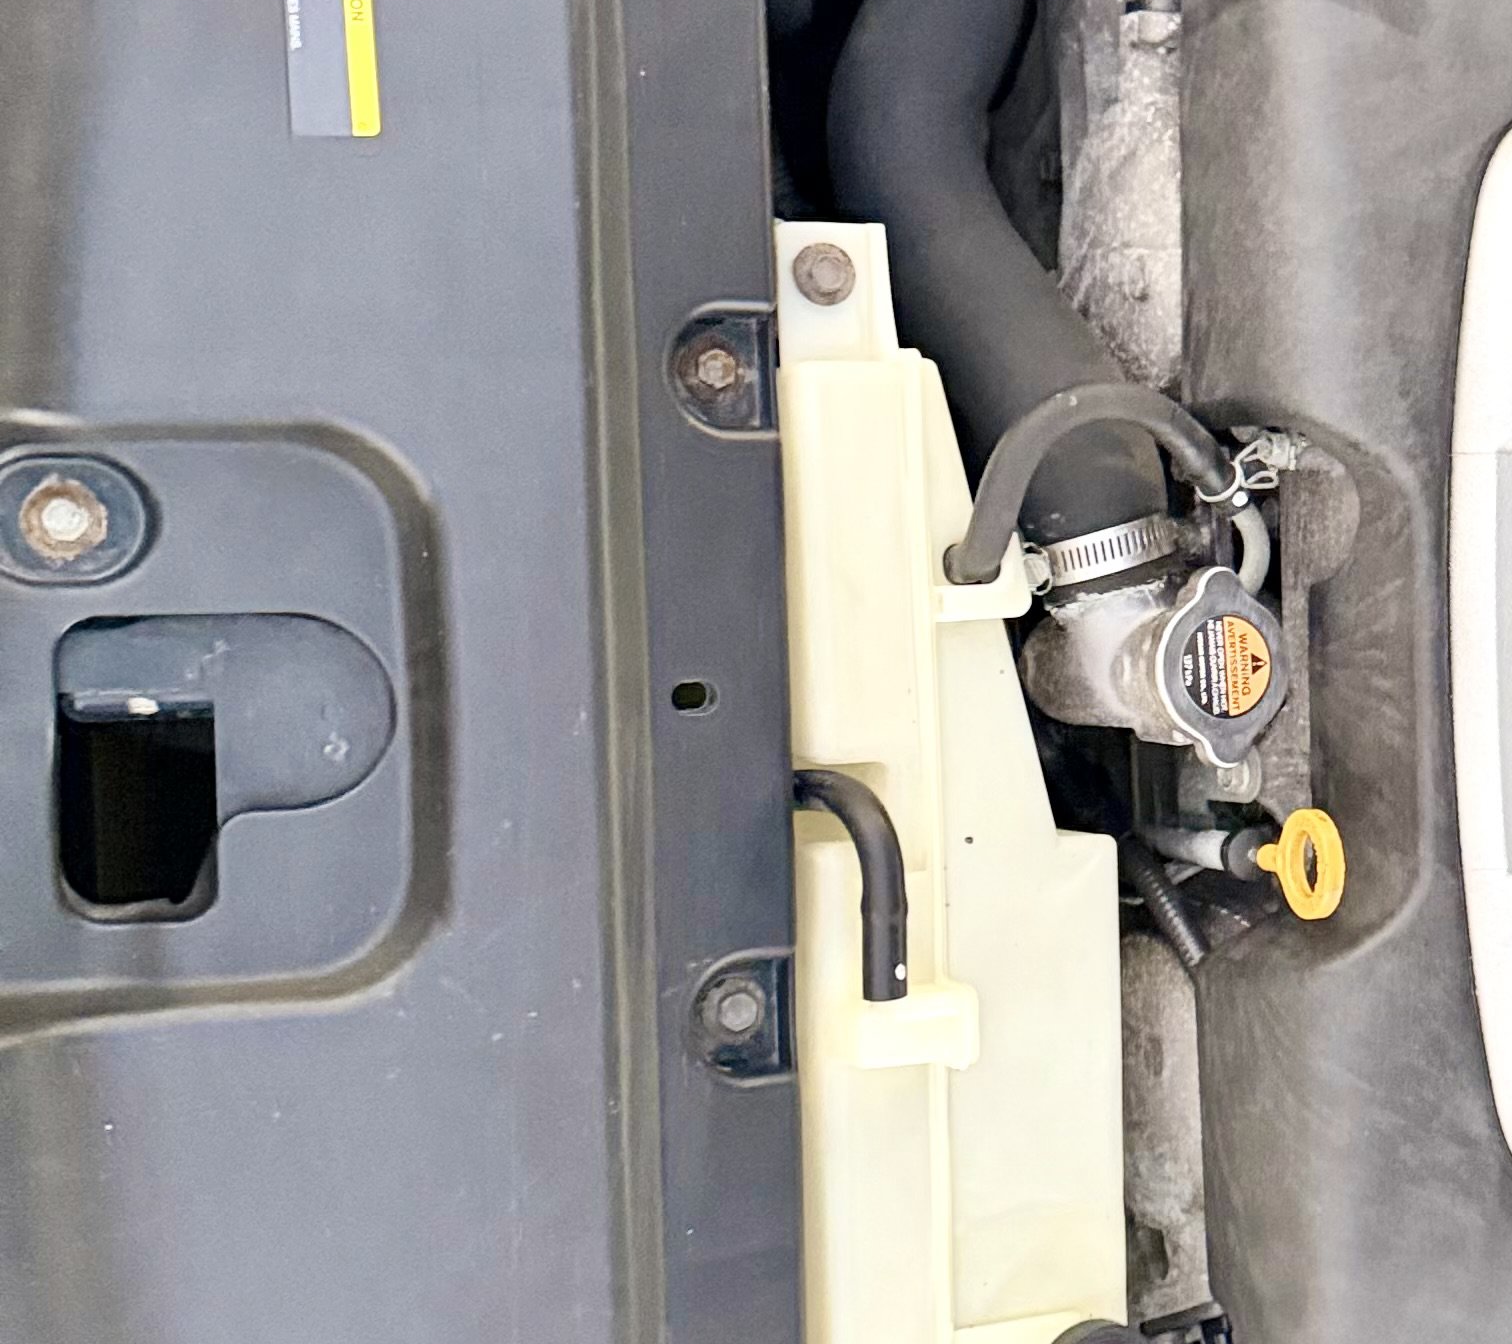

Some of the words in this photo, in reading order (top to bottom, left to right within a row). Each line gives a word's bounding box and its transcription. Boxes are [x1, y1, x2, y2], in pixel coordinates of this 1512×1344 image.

[1215, 621, 1224, 646] NEVER
[1217, 647, 1226, 669] OPEN
[1227, 621, 1240, 710] AVERTISSEMENT
[1238, 633, 1251, 696] WARNING
[1218, 670, 1227, 694] WHEN
